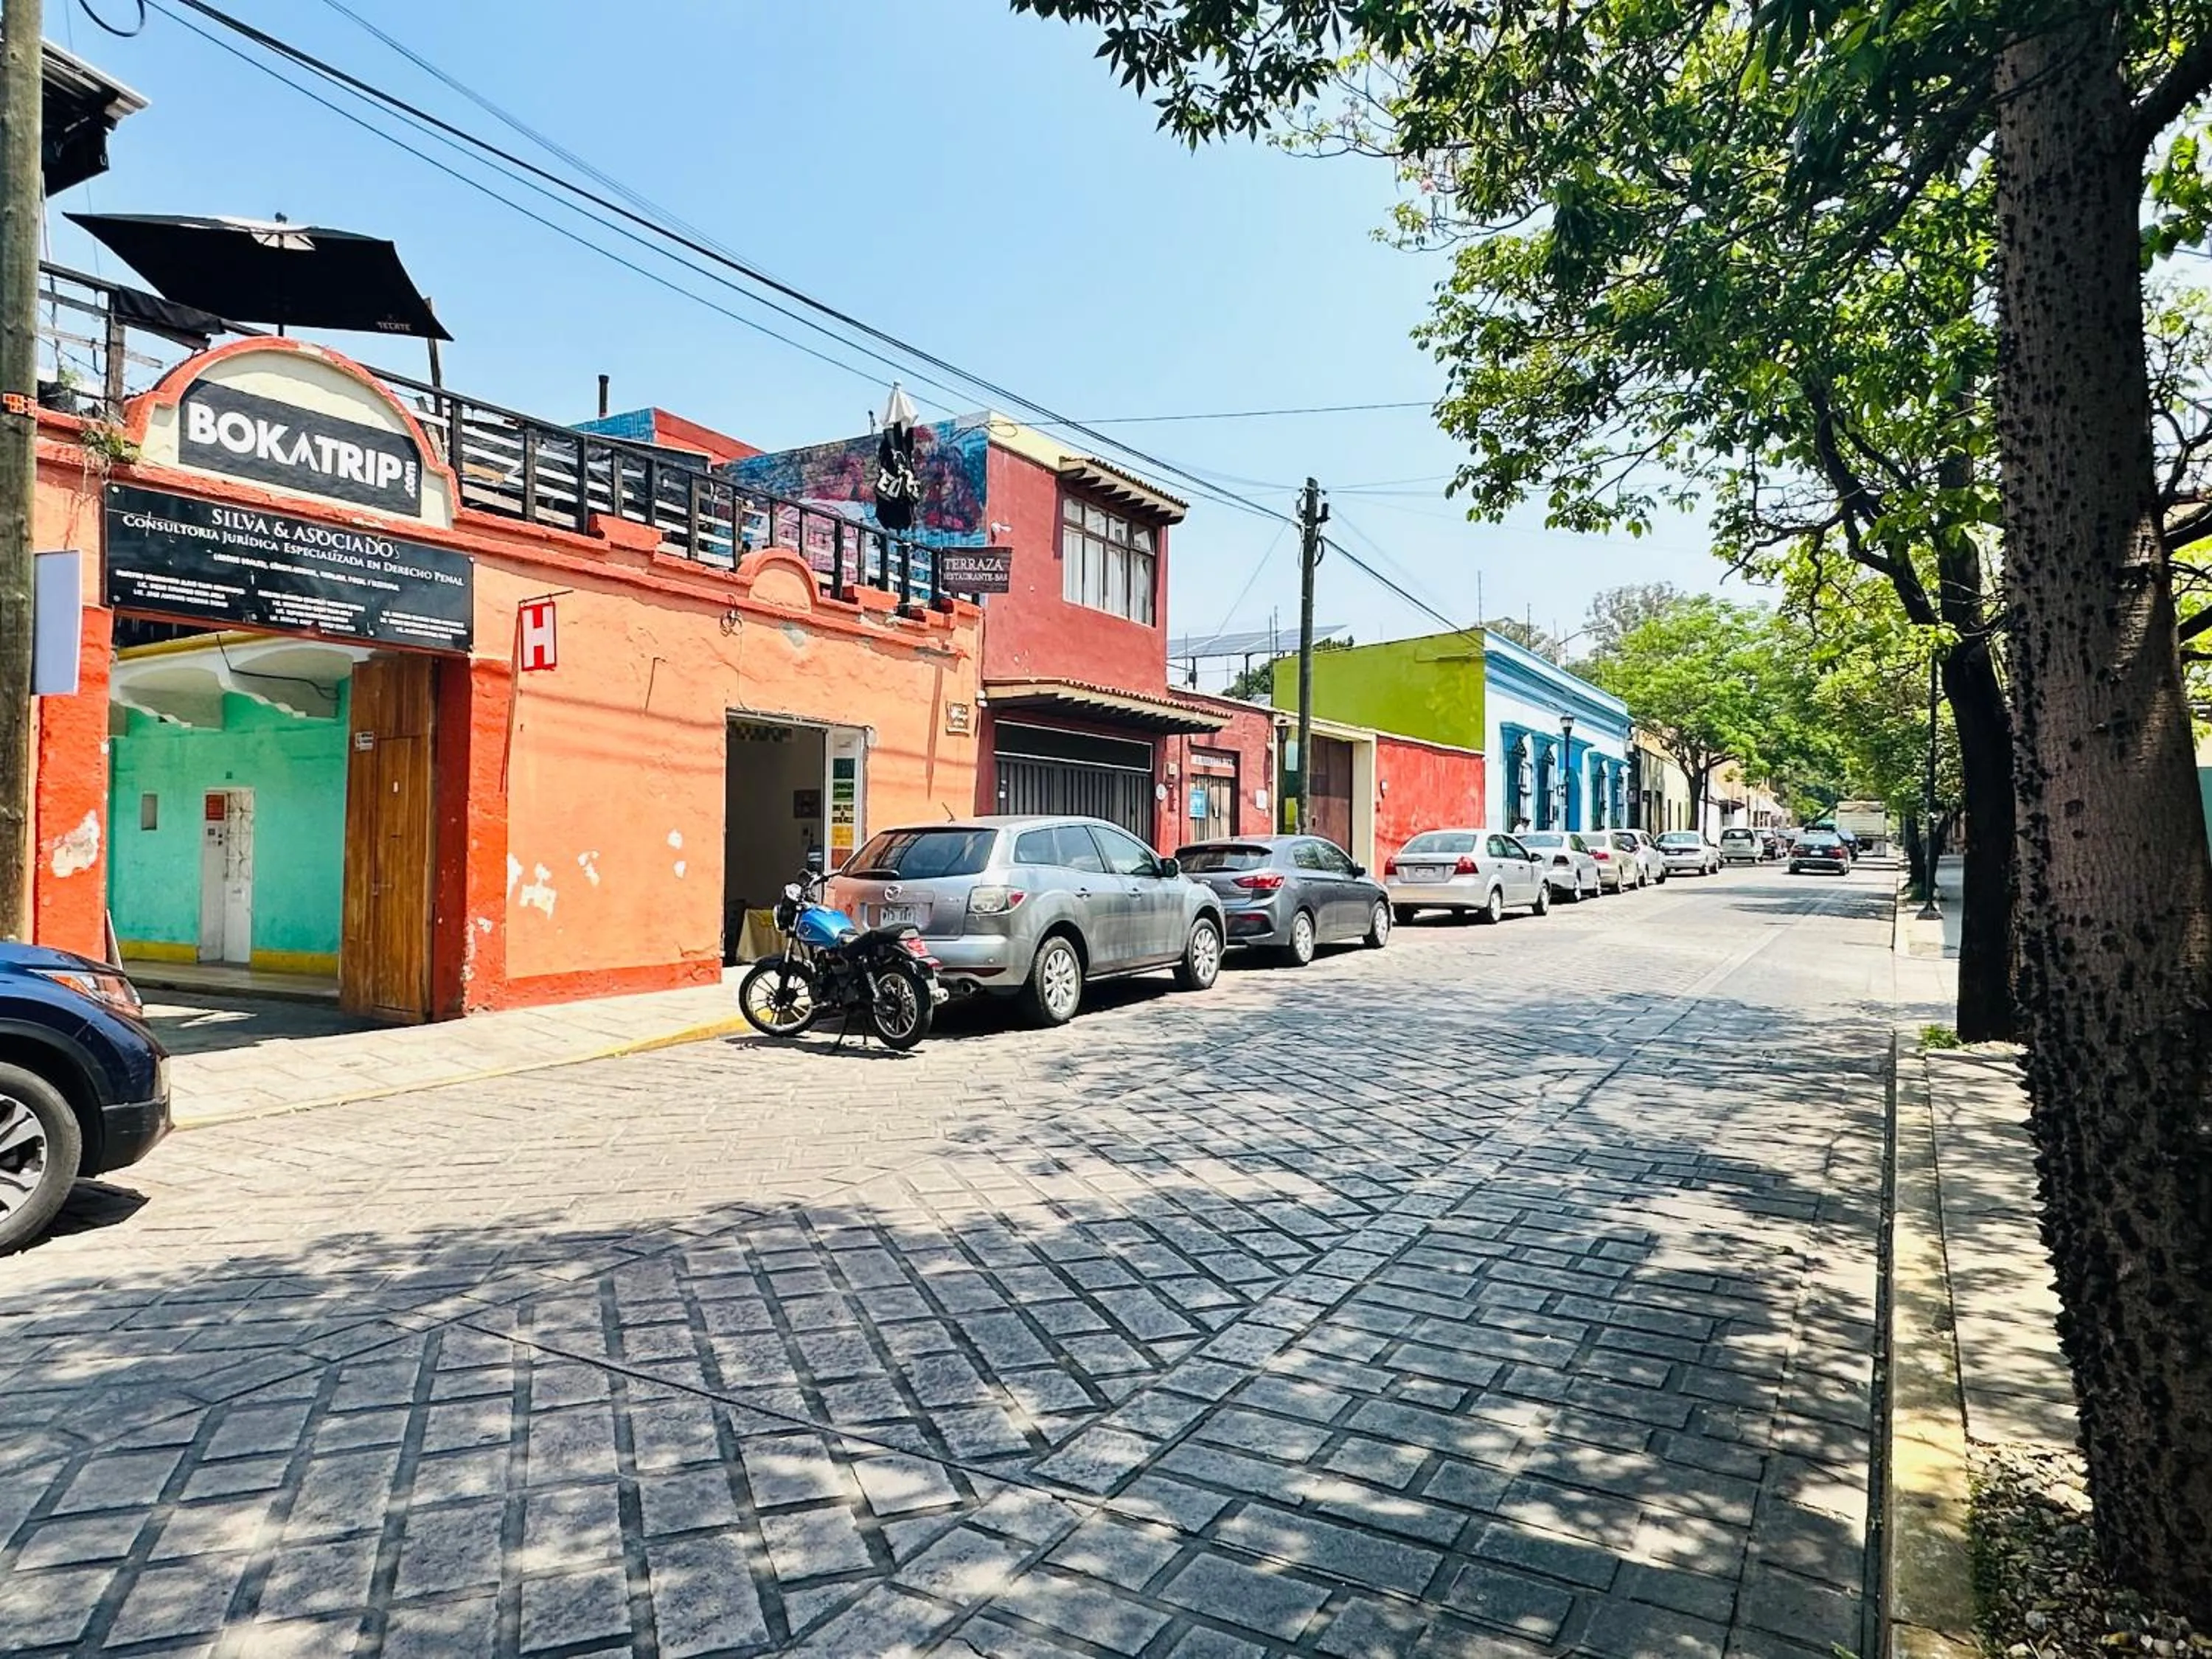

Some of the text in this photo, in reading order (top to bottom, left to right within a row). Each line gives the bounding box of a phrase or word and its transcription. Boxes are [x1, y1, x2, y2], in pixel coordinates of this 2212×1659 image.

[188, 402, 402, 488] BOKATRIP
[212, 508, 269, 535] SILVA
[274, 521, 291, 539] &
[366, 559, 381, 571] EN
[383, 561, 433, 580] DERECHO
[434, 571, 465, 587] PENAL
[944, 557, 1004, 571] TERRAZA
[522, 605, 554, 667] H
